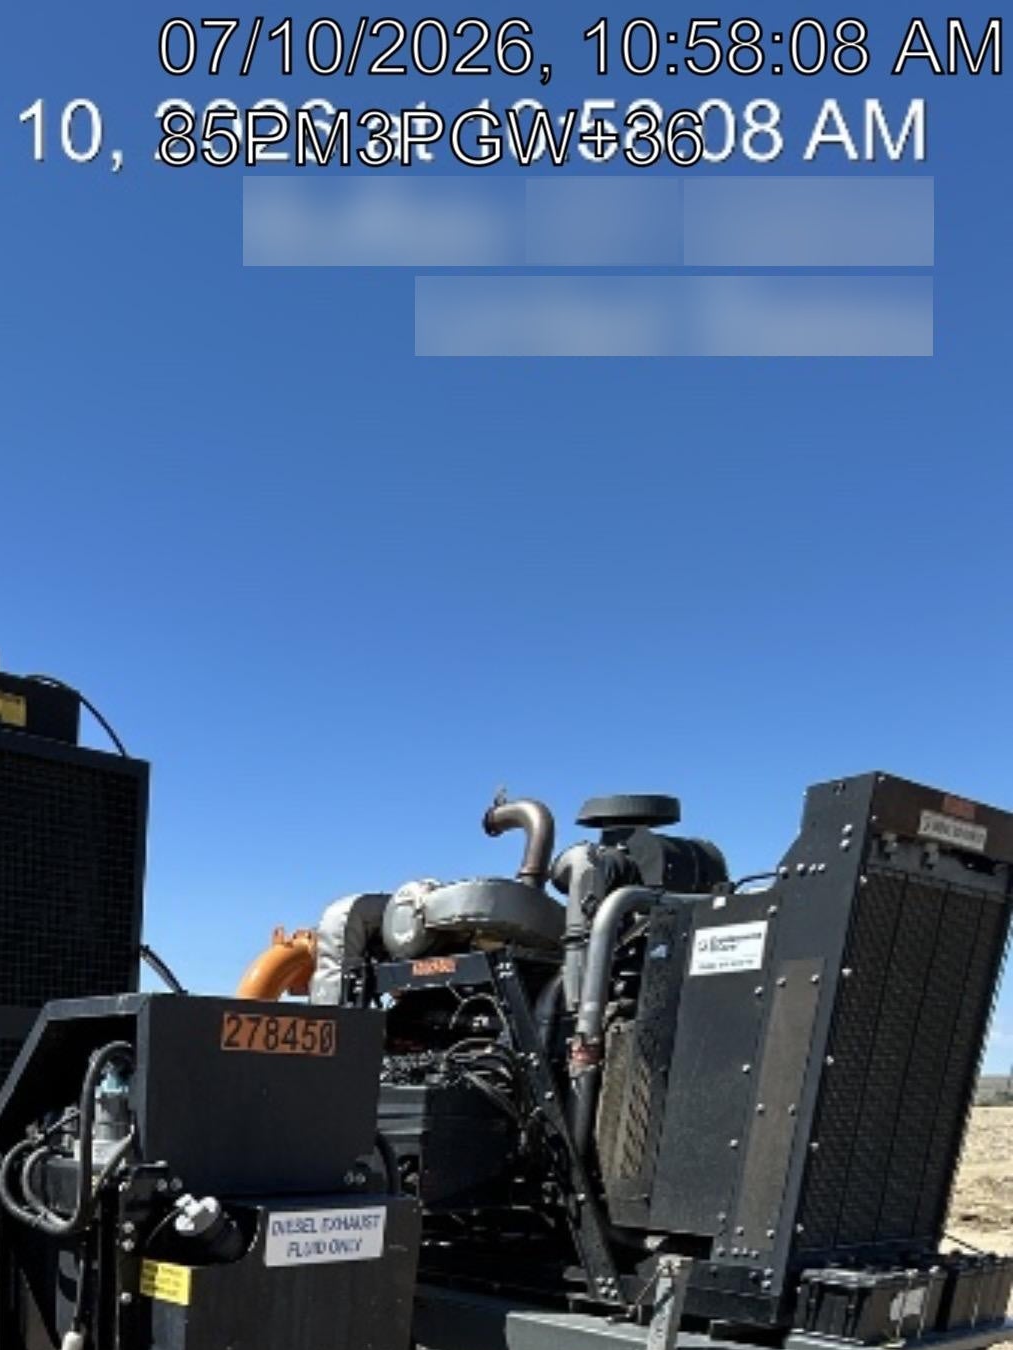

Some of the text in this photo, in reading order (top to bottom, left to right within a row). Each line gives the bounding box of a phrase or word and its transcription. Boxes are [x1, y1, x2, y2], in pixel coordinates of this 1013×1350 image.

[223, 1015, 333, 1053] 278450
[271, 1214, 381, 1236] DIESEL EXHAUST
